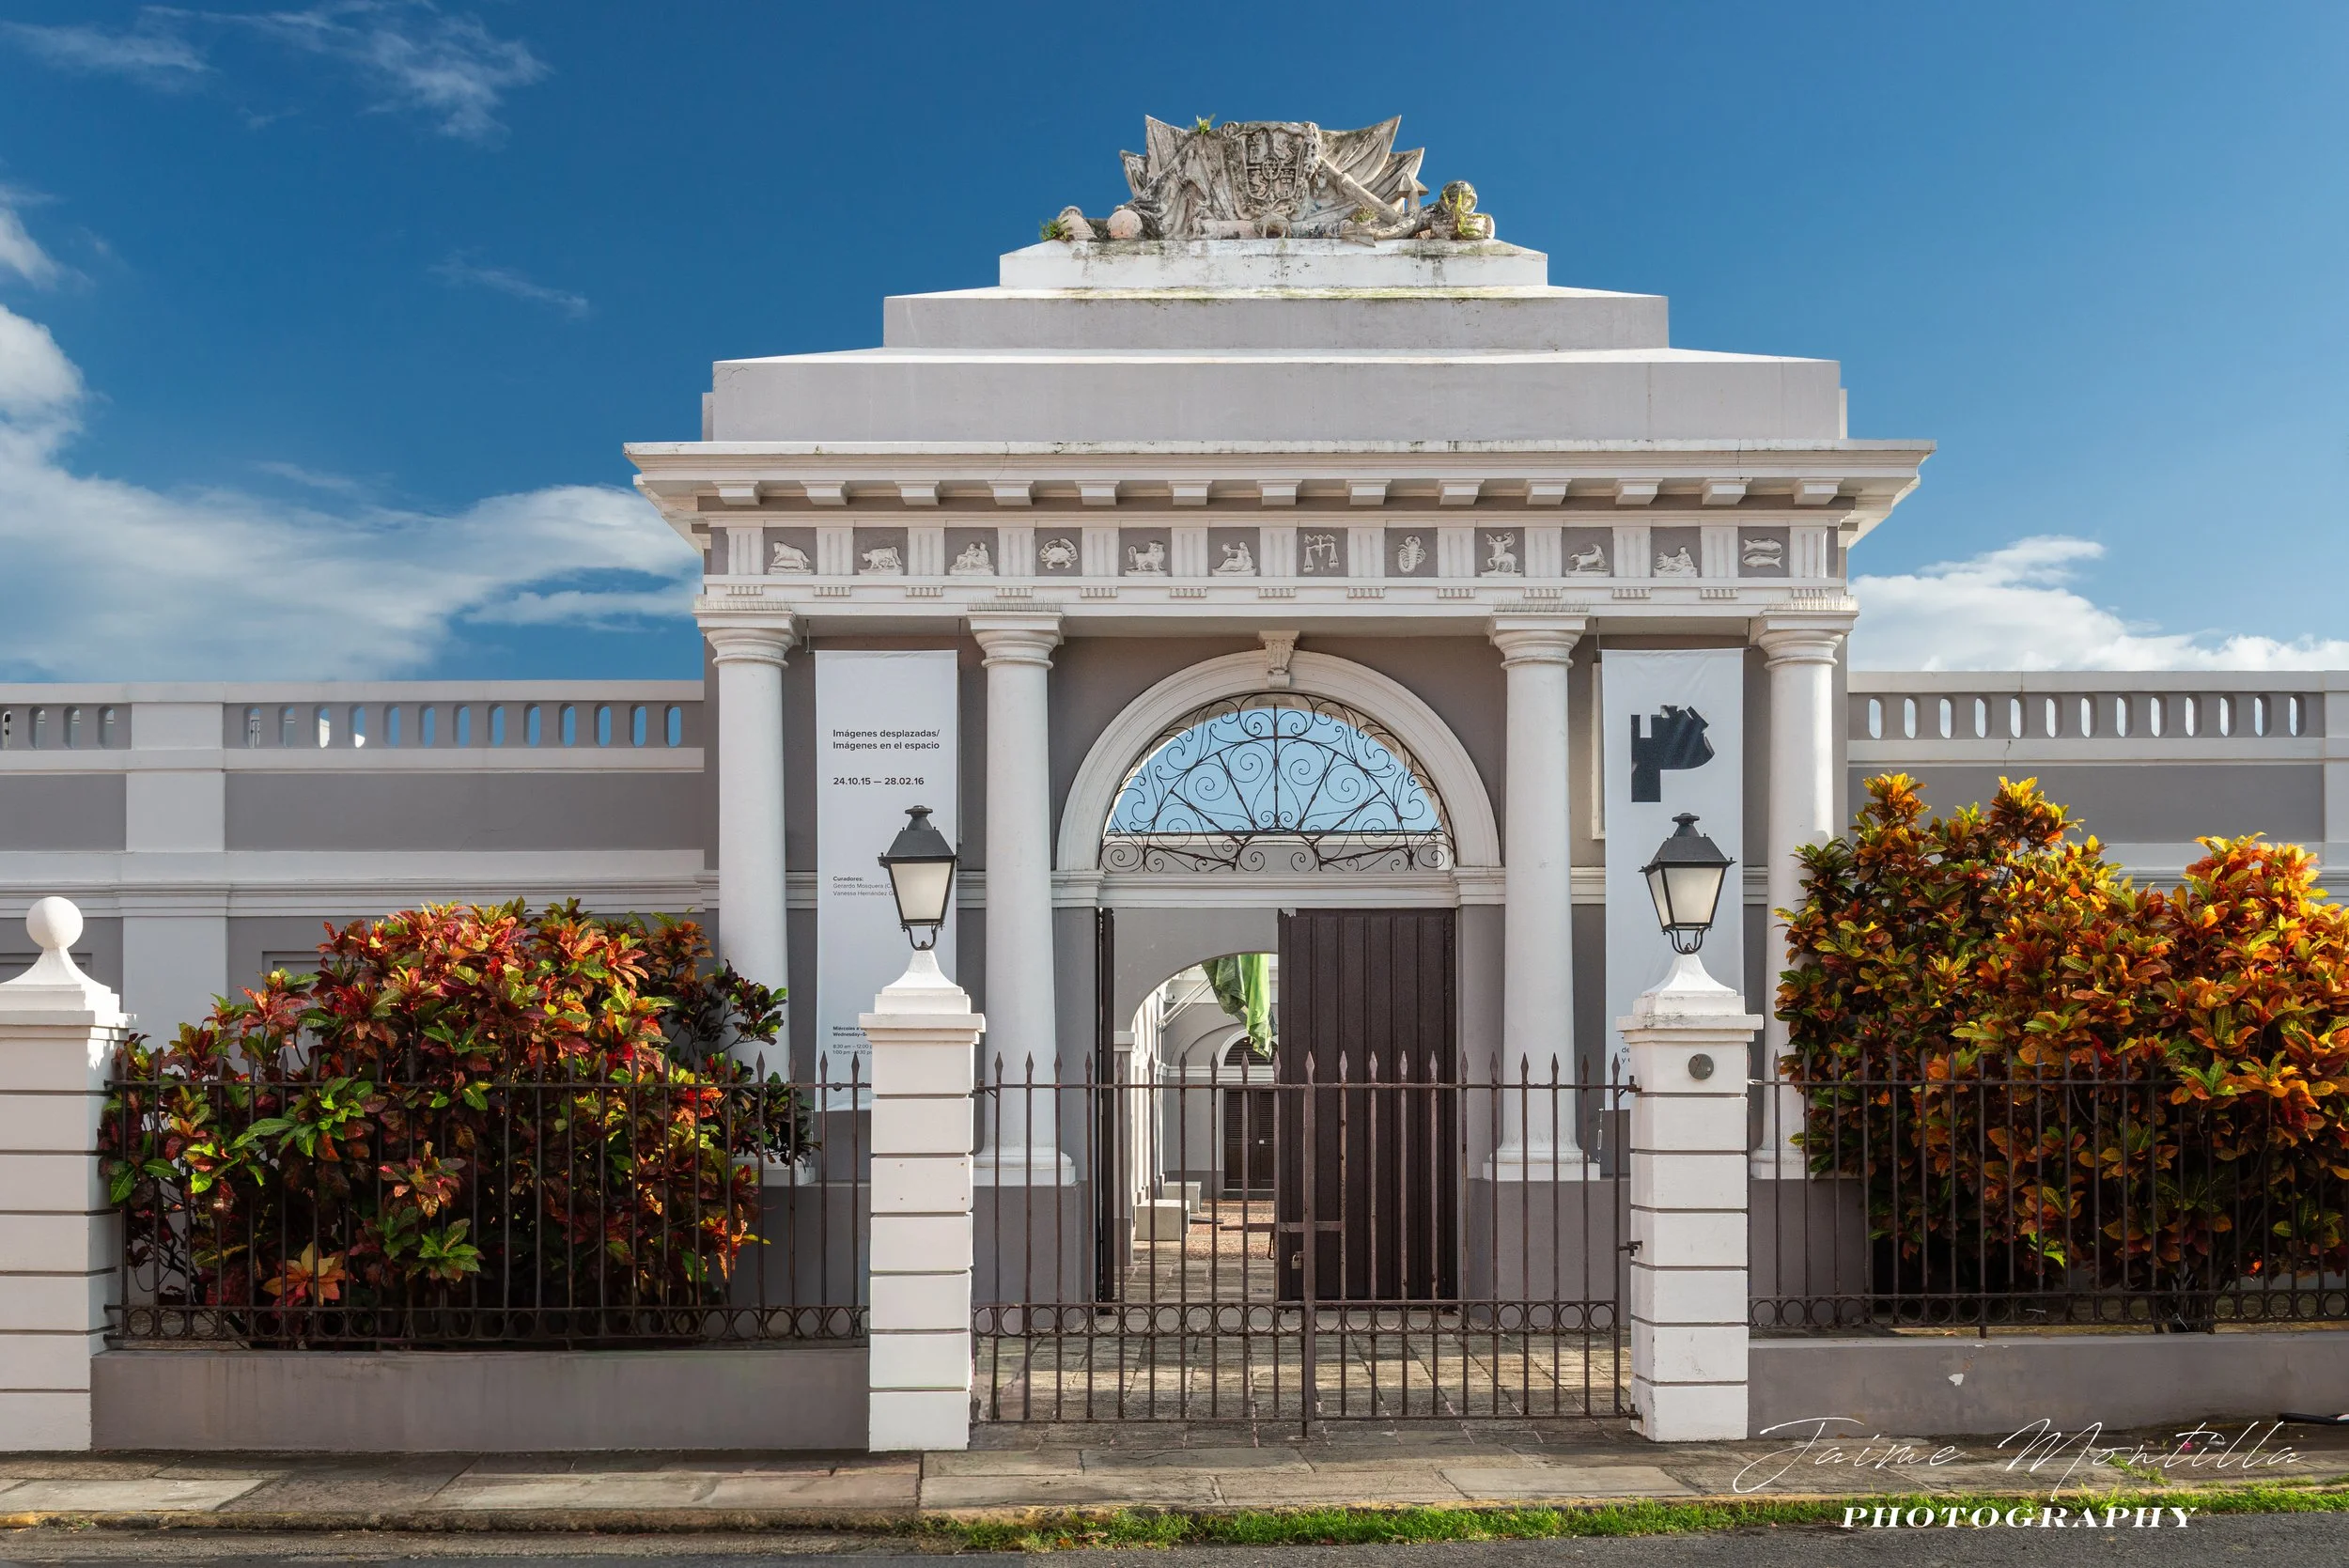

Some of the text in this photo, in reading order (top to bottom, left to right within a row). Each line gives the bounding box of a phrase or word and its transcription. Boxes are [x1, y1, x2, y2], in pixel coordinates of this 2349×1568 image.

[832, 729, 940, 738] Imágenes desplazadas/
[832, 741, 878, 751] Imágenes
[894, 741, 902, 750] el
[904, 741, 940, 751] espacio
[832, 777, 871, 785] 24.10.15
[884, 777, 925, 785] 28.02.16
